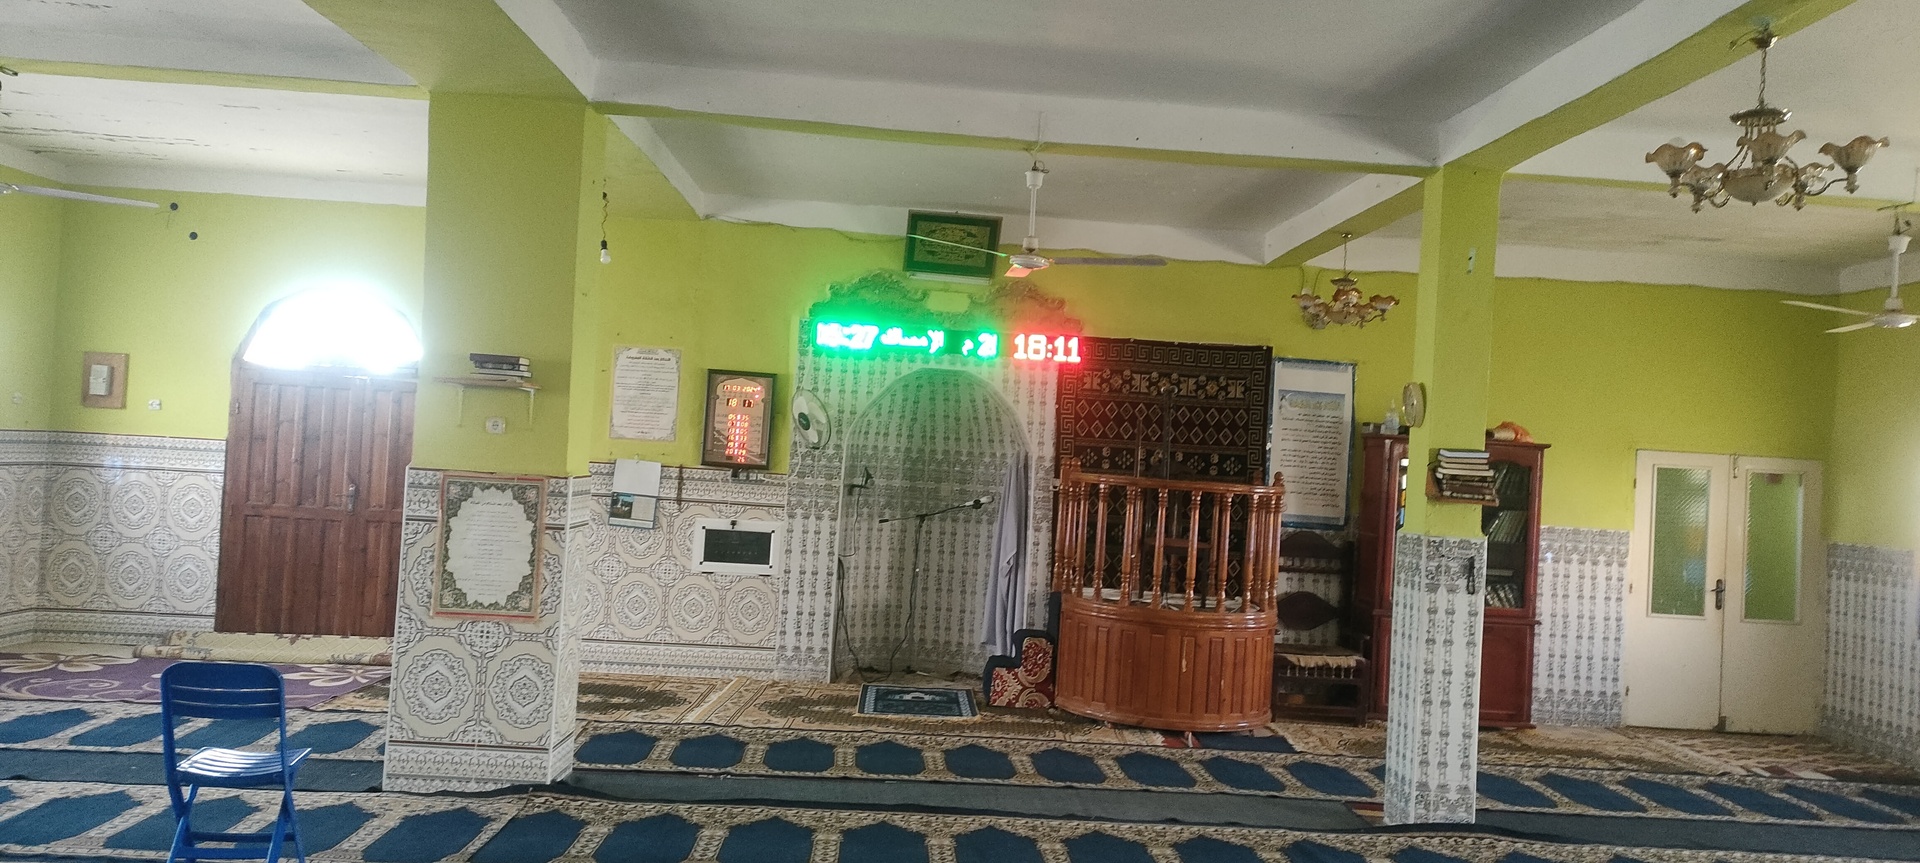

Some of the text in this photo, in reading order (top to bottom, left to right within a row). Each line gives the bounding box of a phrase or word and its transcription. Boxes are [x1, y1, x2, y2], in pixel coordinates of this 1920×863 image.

[1013, 333, 1081, 362] 18:11
[728, 398, 754, 408] 18 17
